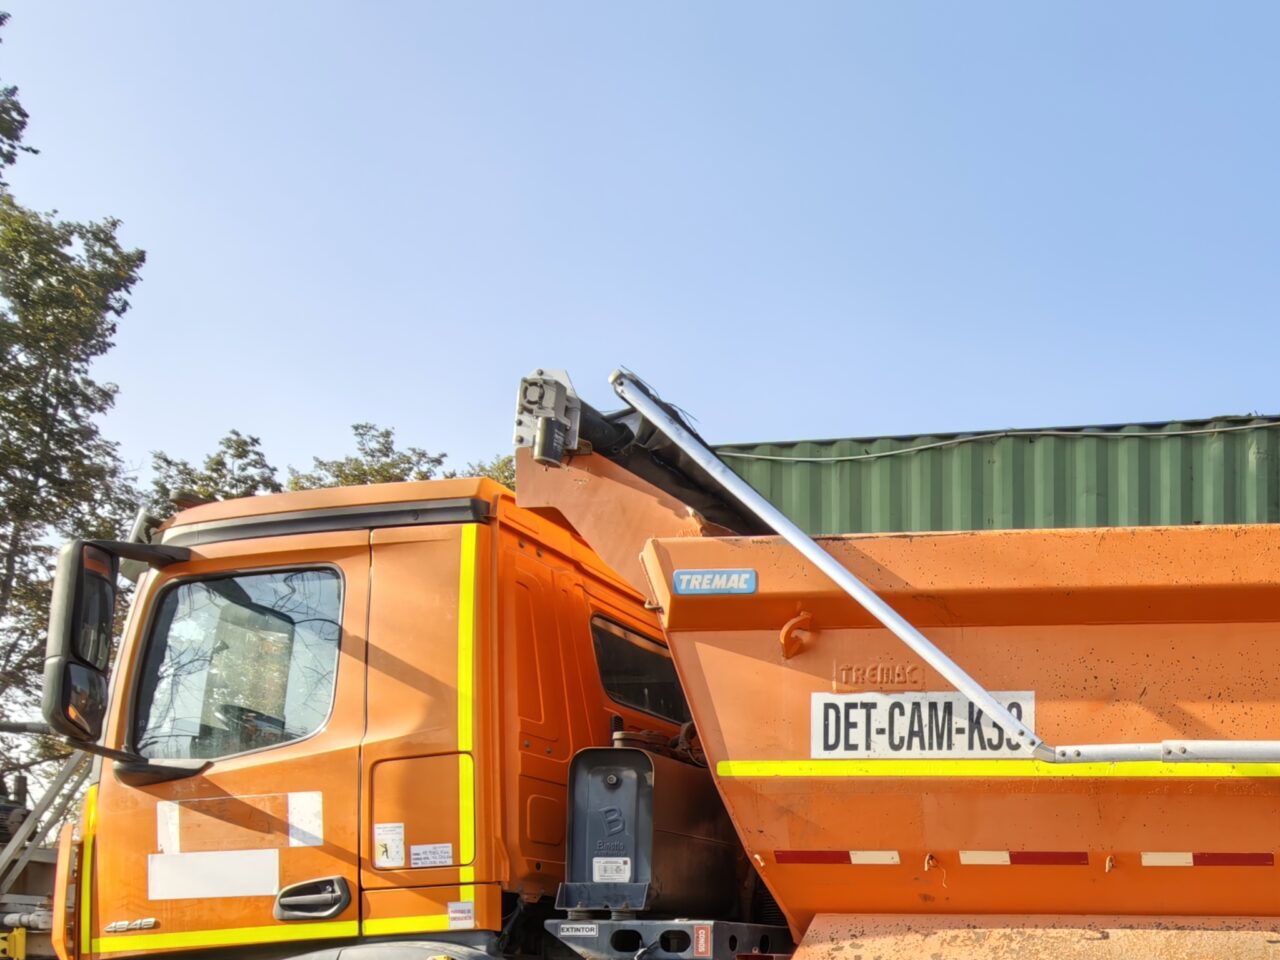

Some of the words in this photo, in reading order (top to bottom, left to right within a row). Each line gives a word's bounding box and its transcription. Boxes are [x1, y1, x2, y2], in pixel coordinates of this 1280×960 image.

[680, 573, 750, 591] TREMAC
[840, 665, 919, 685] TREMAC
[698, 929, 706, 952] CONOS
